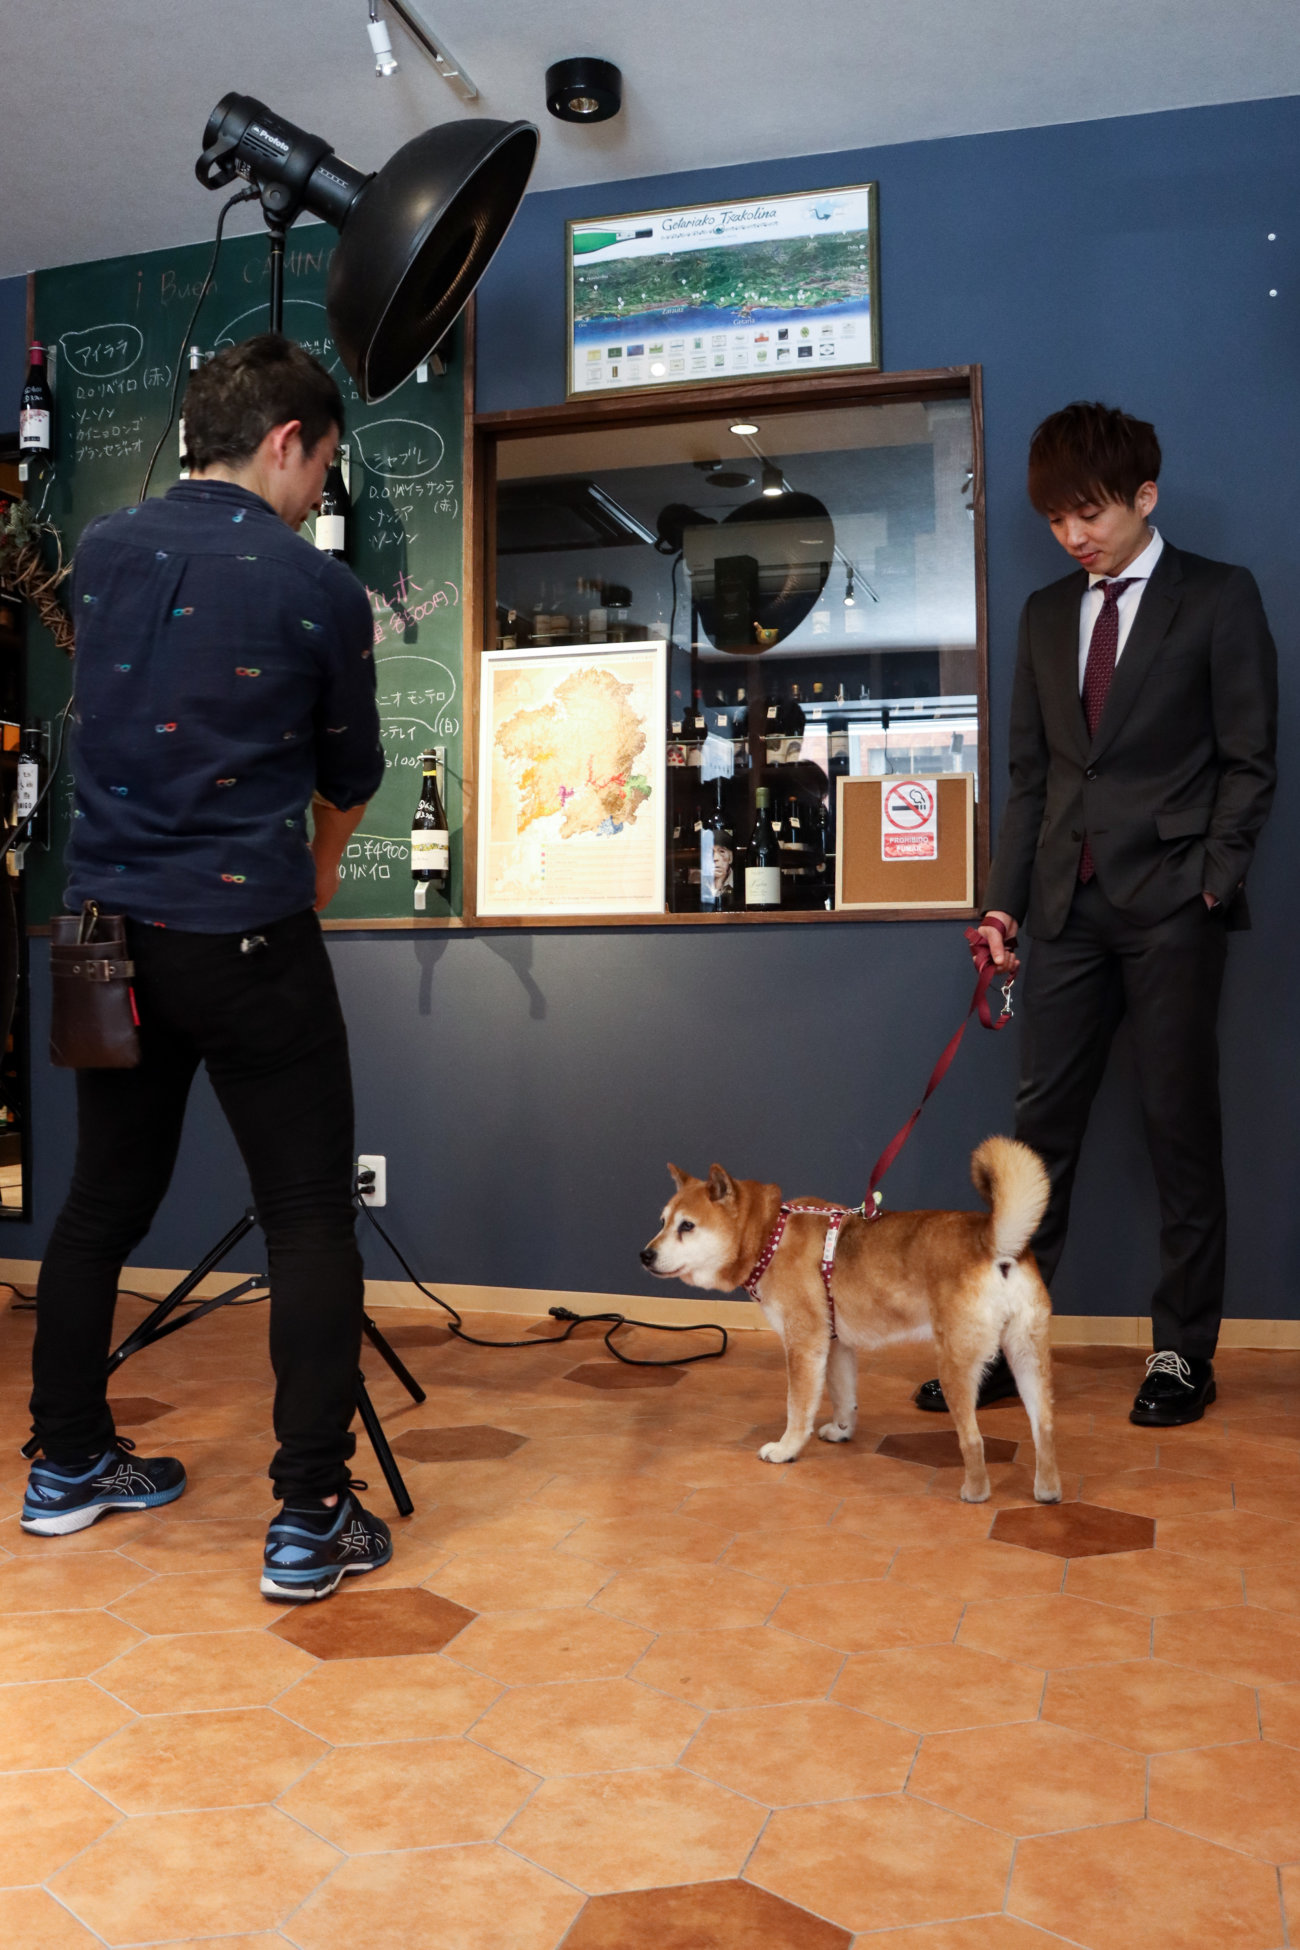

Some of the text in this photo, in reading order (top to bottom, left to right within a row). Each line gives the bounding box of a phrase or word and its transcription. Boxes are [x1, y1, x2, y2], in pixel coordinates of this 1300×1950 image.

[259, 129, 290, 152] Profoto
[720, 206, 777, 225] Txakolina
[243, 247, 335, 284] CAMIN
[75, 339, 128, 367] アイララ
[363, 839, 409, 861] ¥4900
